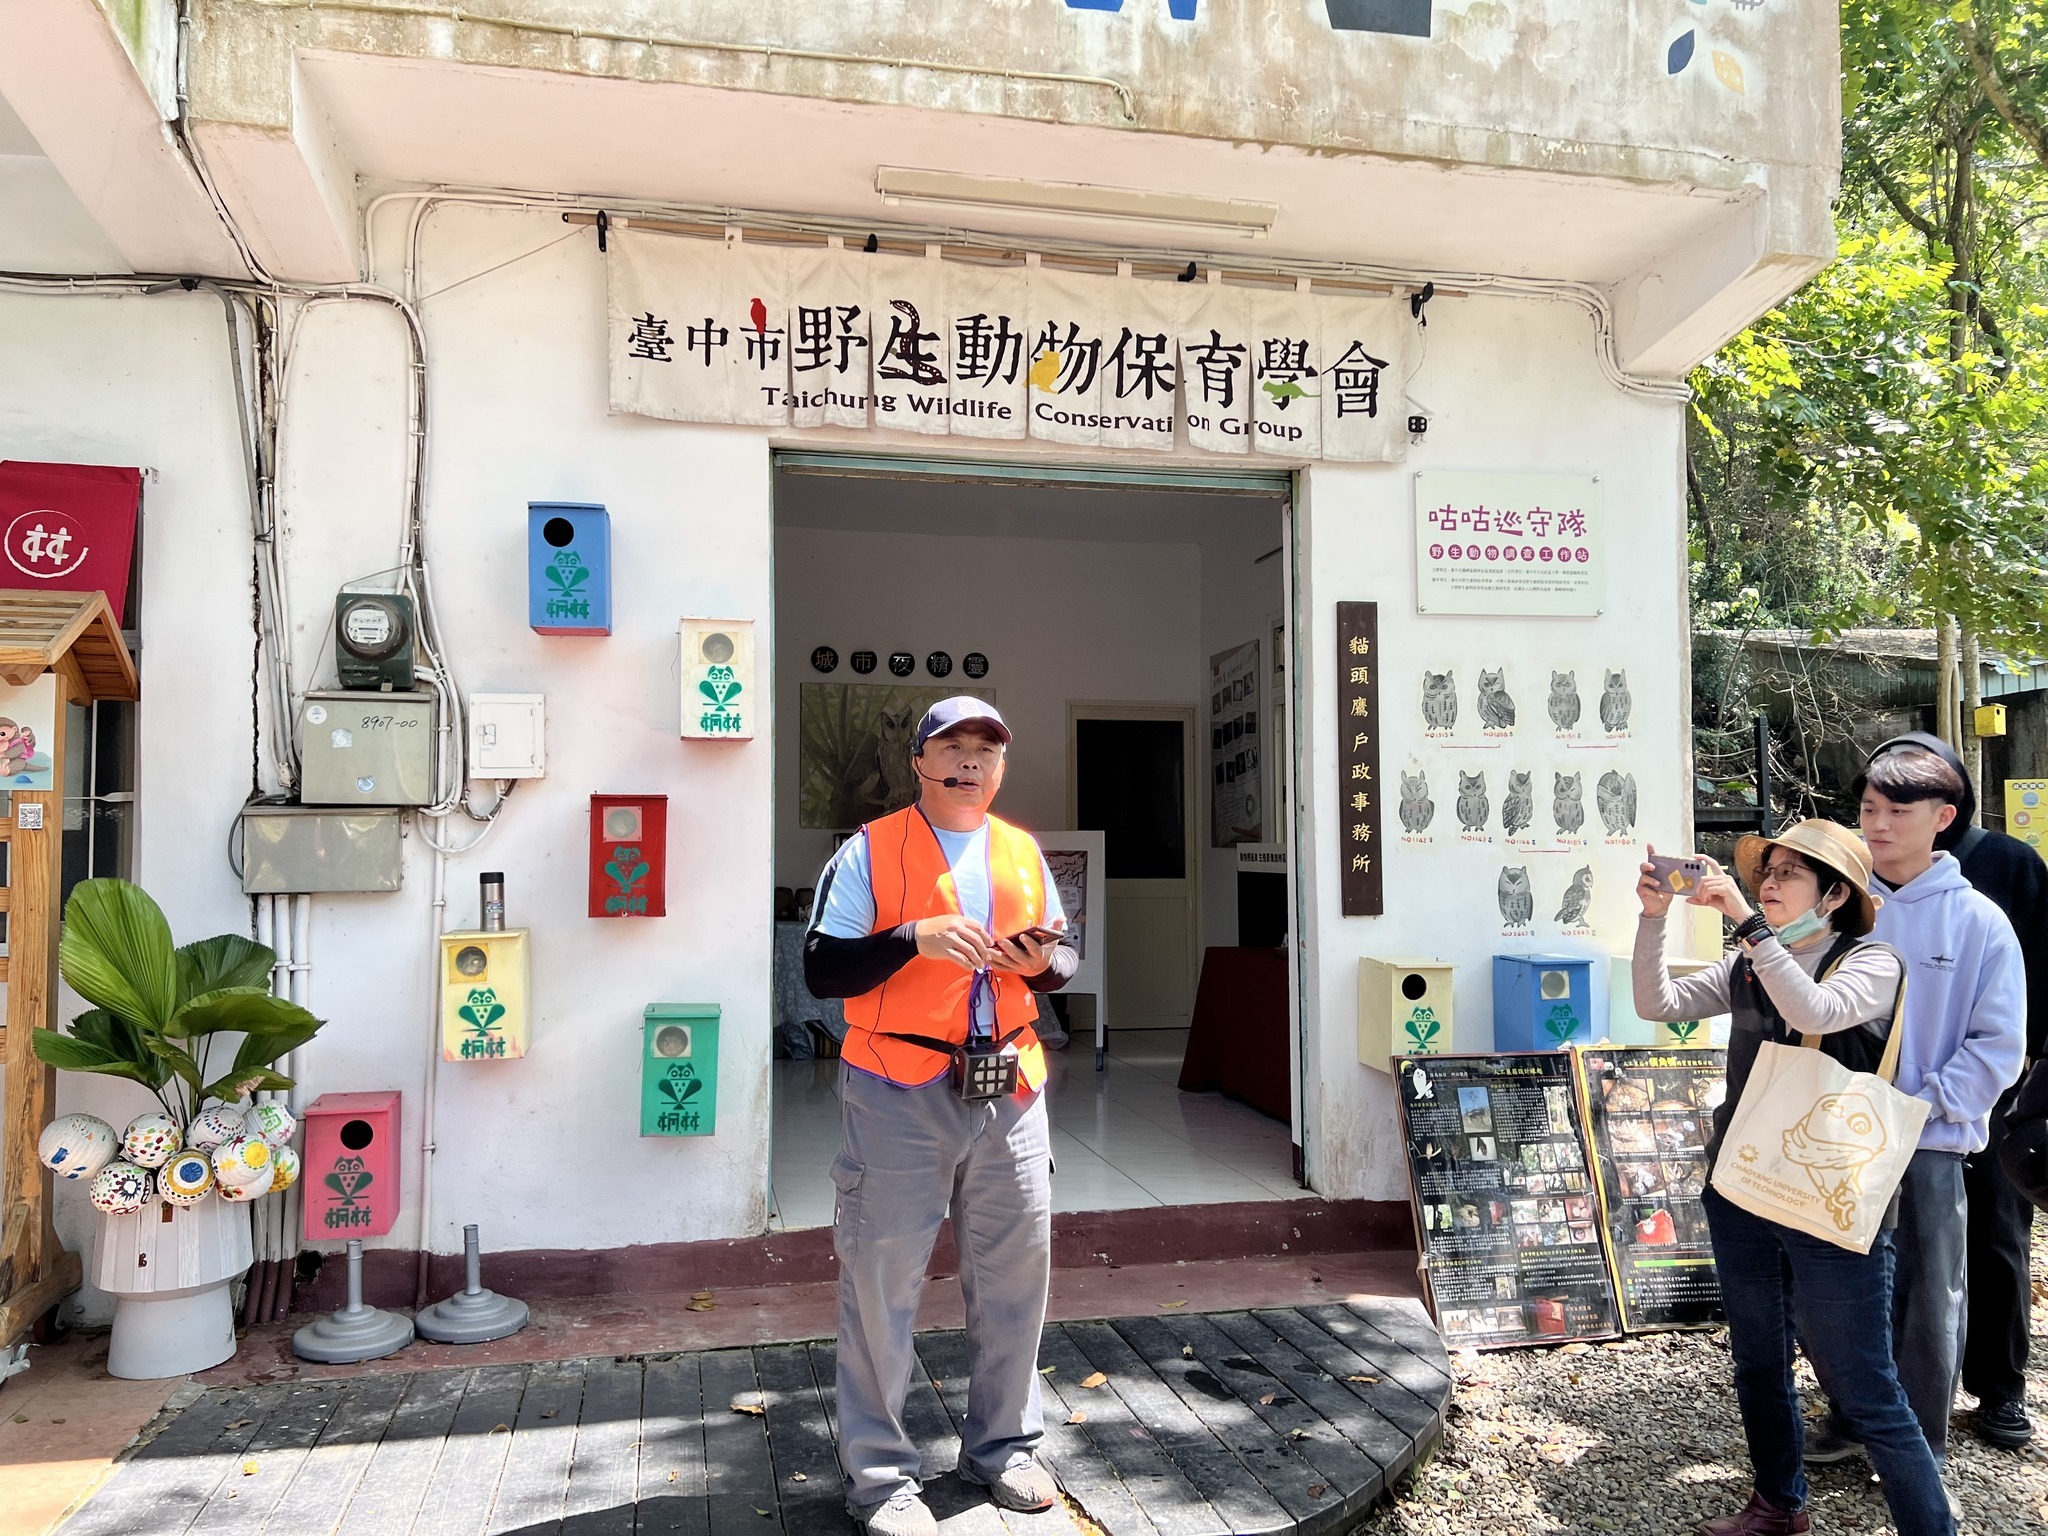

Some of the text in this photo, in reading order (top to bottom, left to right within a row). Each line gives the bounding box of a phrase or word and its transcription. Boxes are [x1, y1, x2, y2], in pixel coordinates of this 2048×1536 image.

[627, 303, 1390, 419] 臺中市野生動物保育學會
[760, 387, 897, 412] Taichung
[907, 393, 1011, 420] Wildlife
[1219, 418, 1303, 442] Group
[1428, 503, 1588, 537] 咕咕巡守隊
[1430, 544, 1589, 562] 野生動物調查工作站
[814, 650, 986, 676] 城市夜精靈
[361, 716, 419, 731] 8907-00
[1348, 635, 1373, 874] 貓頭鷹戶政事務所
[1730, 1162, 1821, 1204] CHAOYANG UNIVERSITY
[1741, 1176, 1807, 1208] OF TECHNOLOGY
